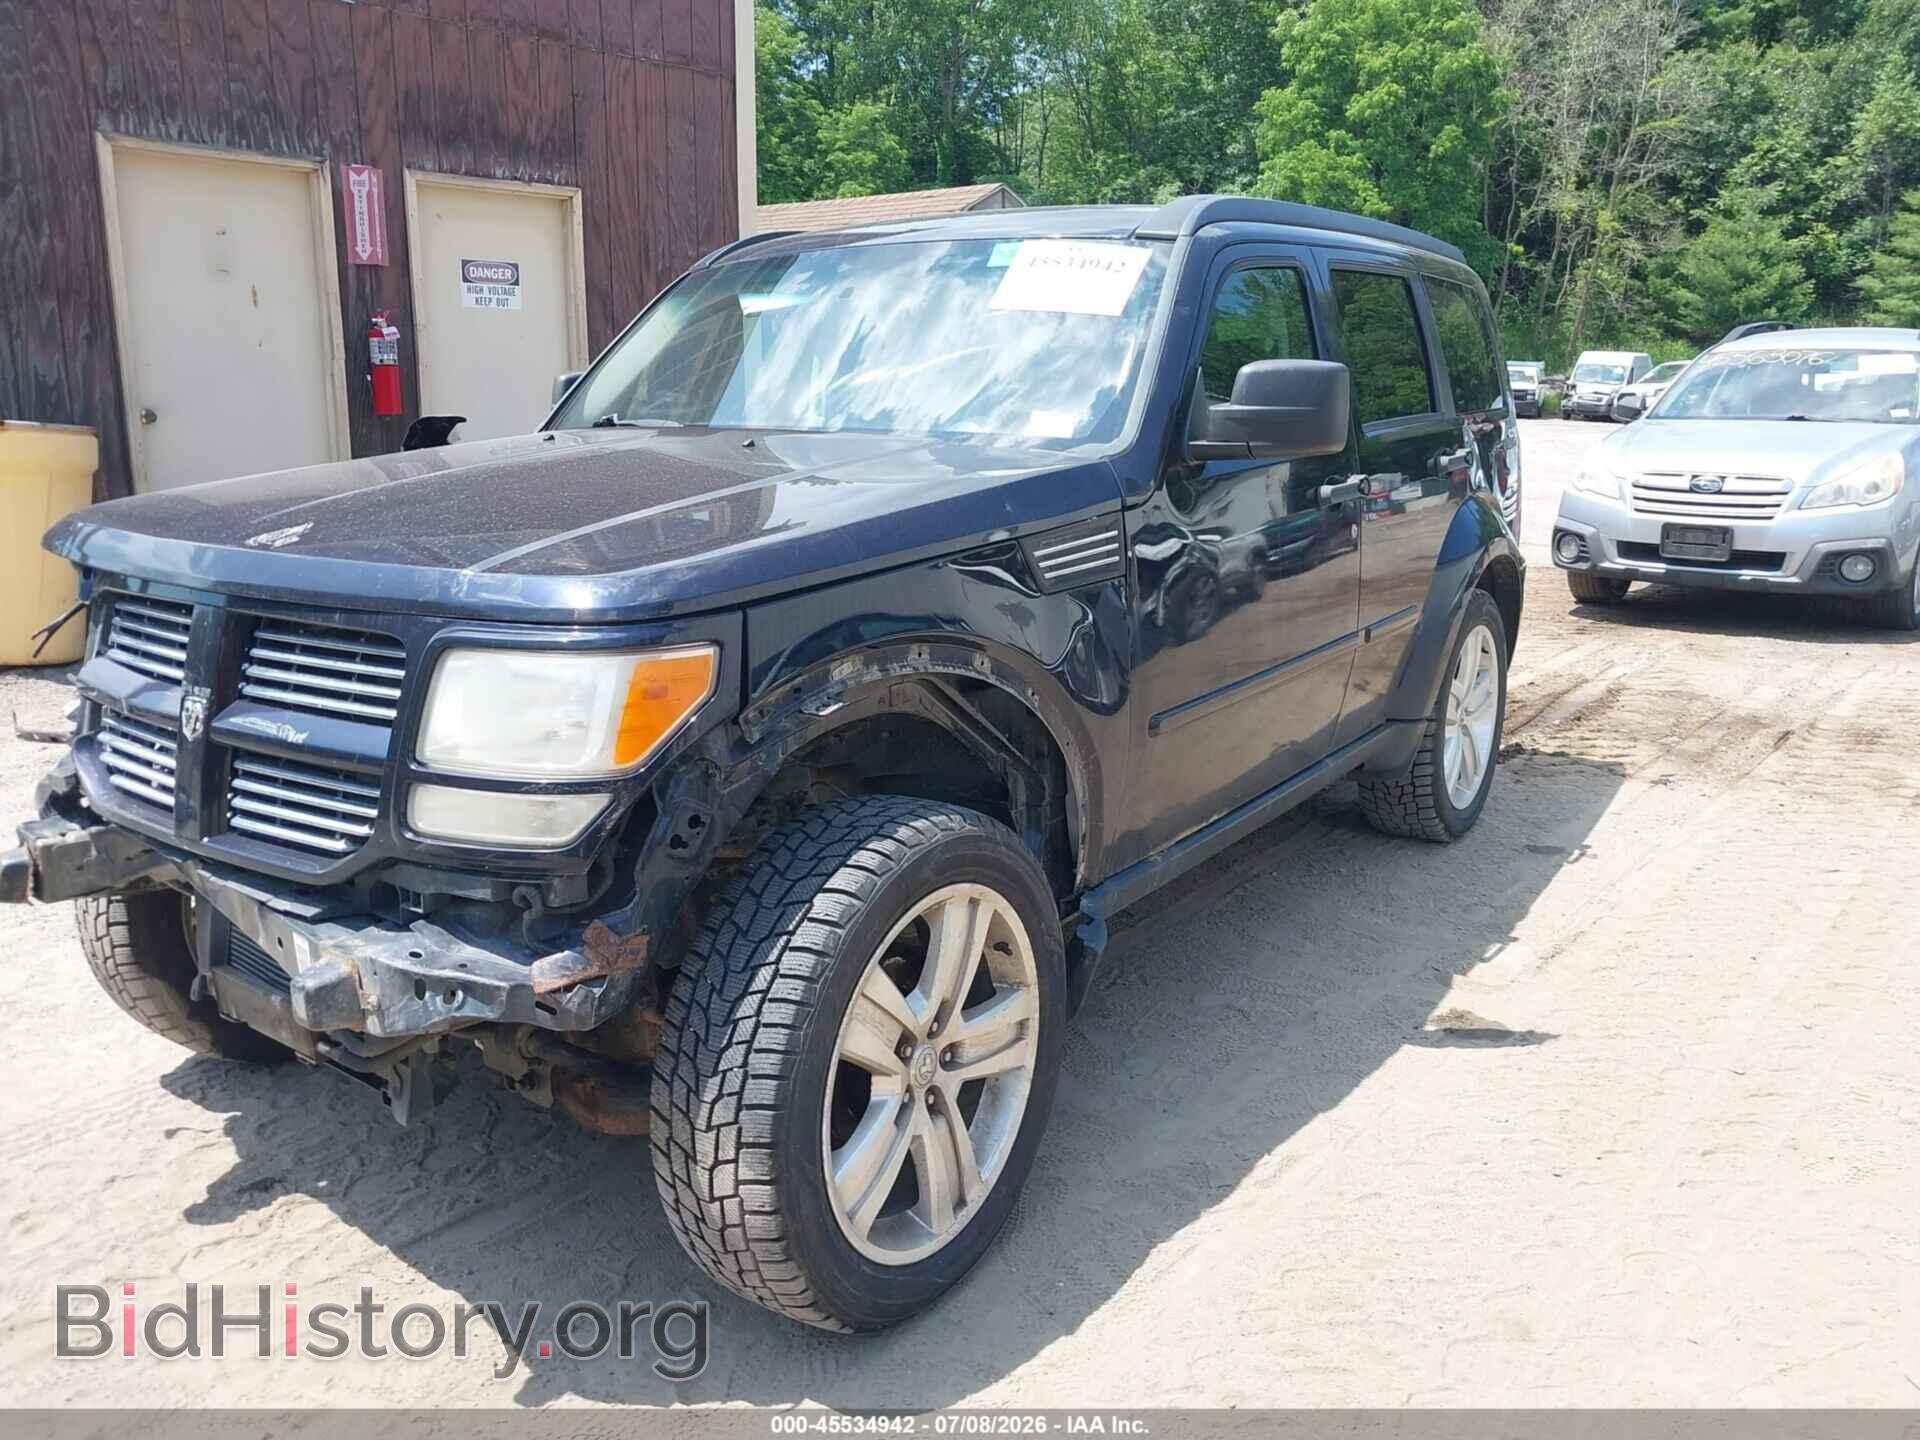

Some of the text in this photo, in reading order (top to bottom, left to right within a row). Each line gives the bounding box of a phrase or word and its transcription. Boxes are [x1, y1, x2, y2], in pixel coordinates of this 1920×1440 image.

[469, 266, 512, 280] DANGER
[467, 285, 516, 297] HIGH VOLTAGE
[475, 296, 510, 308] KEEP OUT
